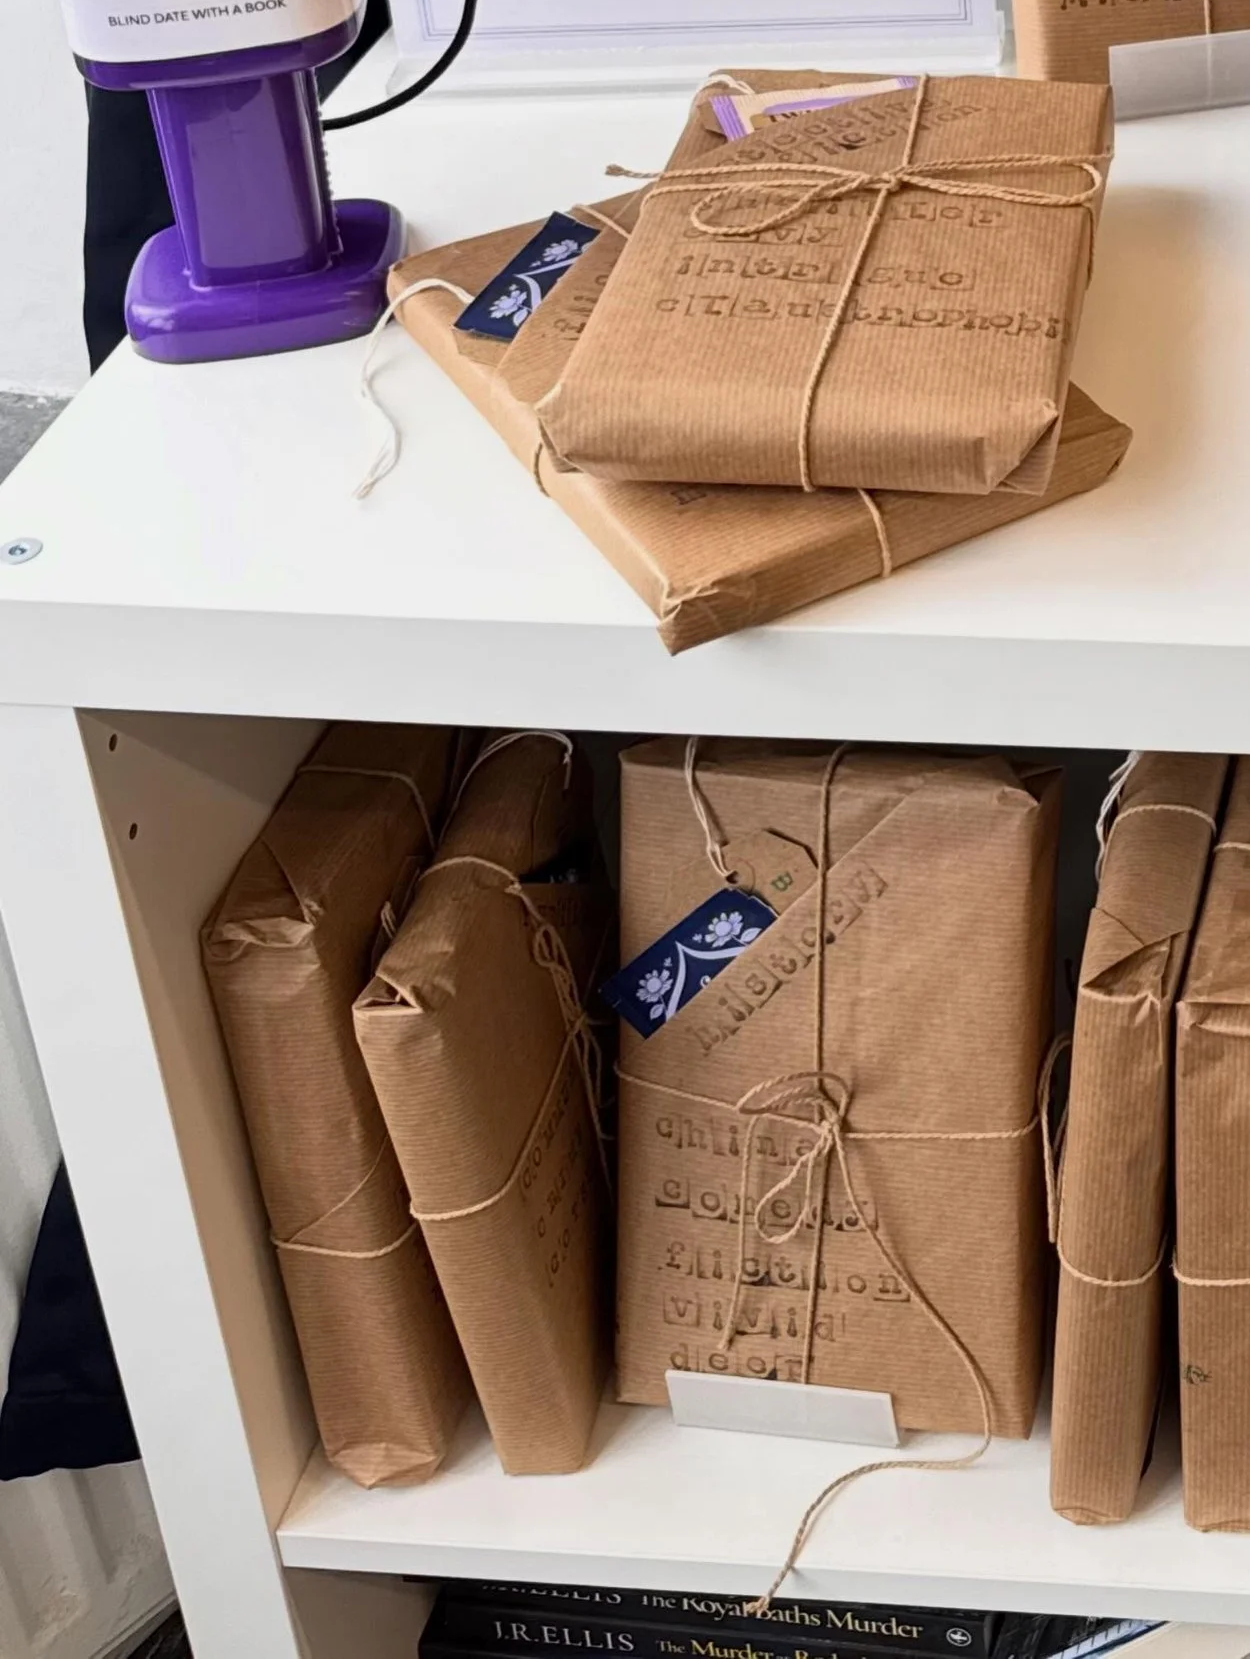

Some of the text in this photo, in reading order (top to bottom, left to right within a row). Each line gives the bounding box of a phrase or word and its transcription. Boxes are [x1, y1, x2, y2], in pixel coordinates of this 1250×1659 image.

[108, 13, 151, 27] BLIND
[154, 9, 190, 25] DATE
[192, 5, 230, 22] WITH
[232, 3, 243, 15] A
[826, 1608, 924, 1640] Murder
[654, 1639, 687, 1655] The
